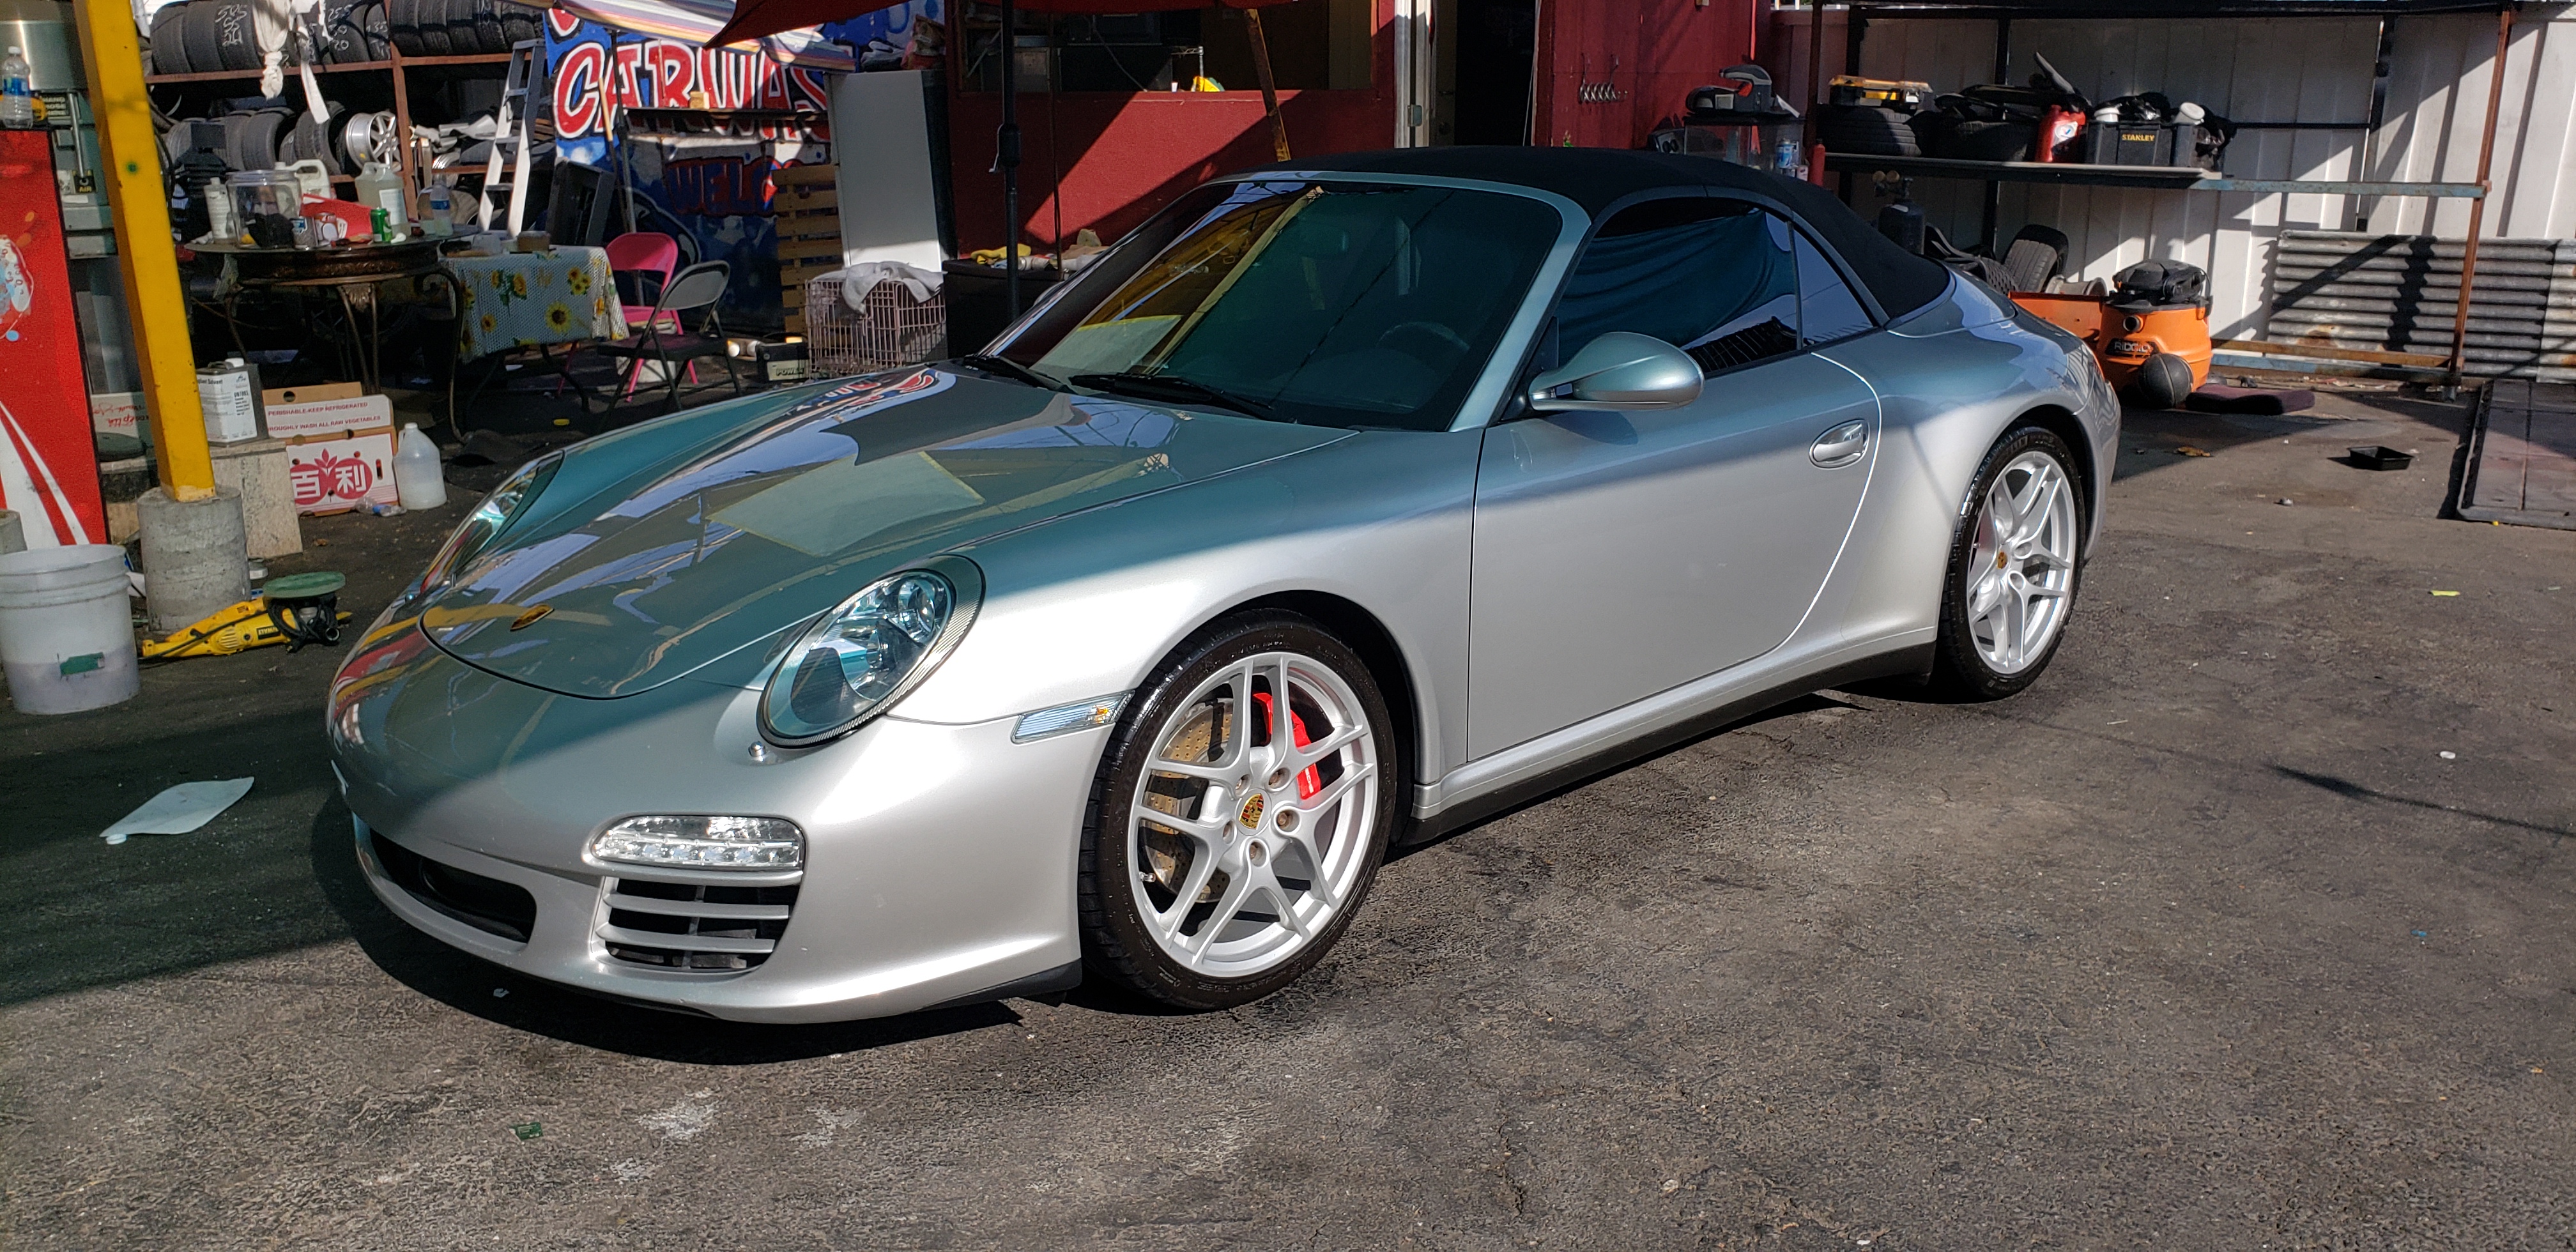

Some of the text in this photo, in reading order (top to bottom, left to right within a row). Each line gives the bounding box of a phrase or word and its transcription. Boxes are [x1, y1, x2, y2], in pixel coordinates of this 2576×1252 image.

[2122, 134, 2155, 142] STANLEY
[666, 156, 804, 216] WELC
[2114, 341, 2151, 353] RIDGID
[268, 402, 368, 416] PERISHABLE-KEEP REFRIGERATED
[344, 415, 381, 425] VEGETABLES
[291, 464, 367, 498] 百利
